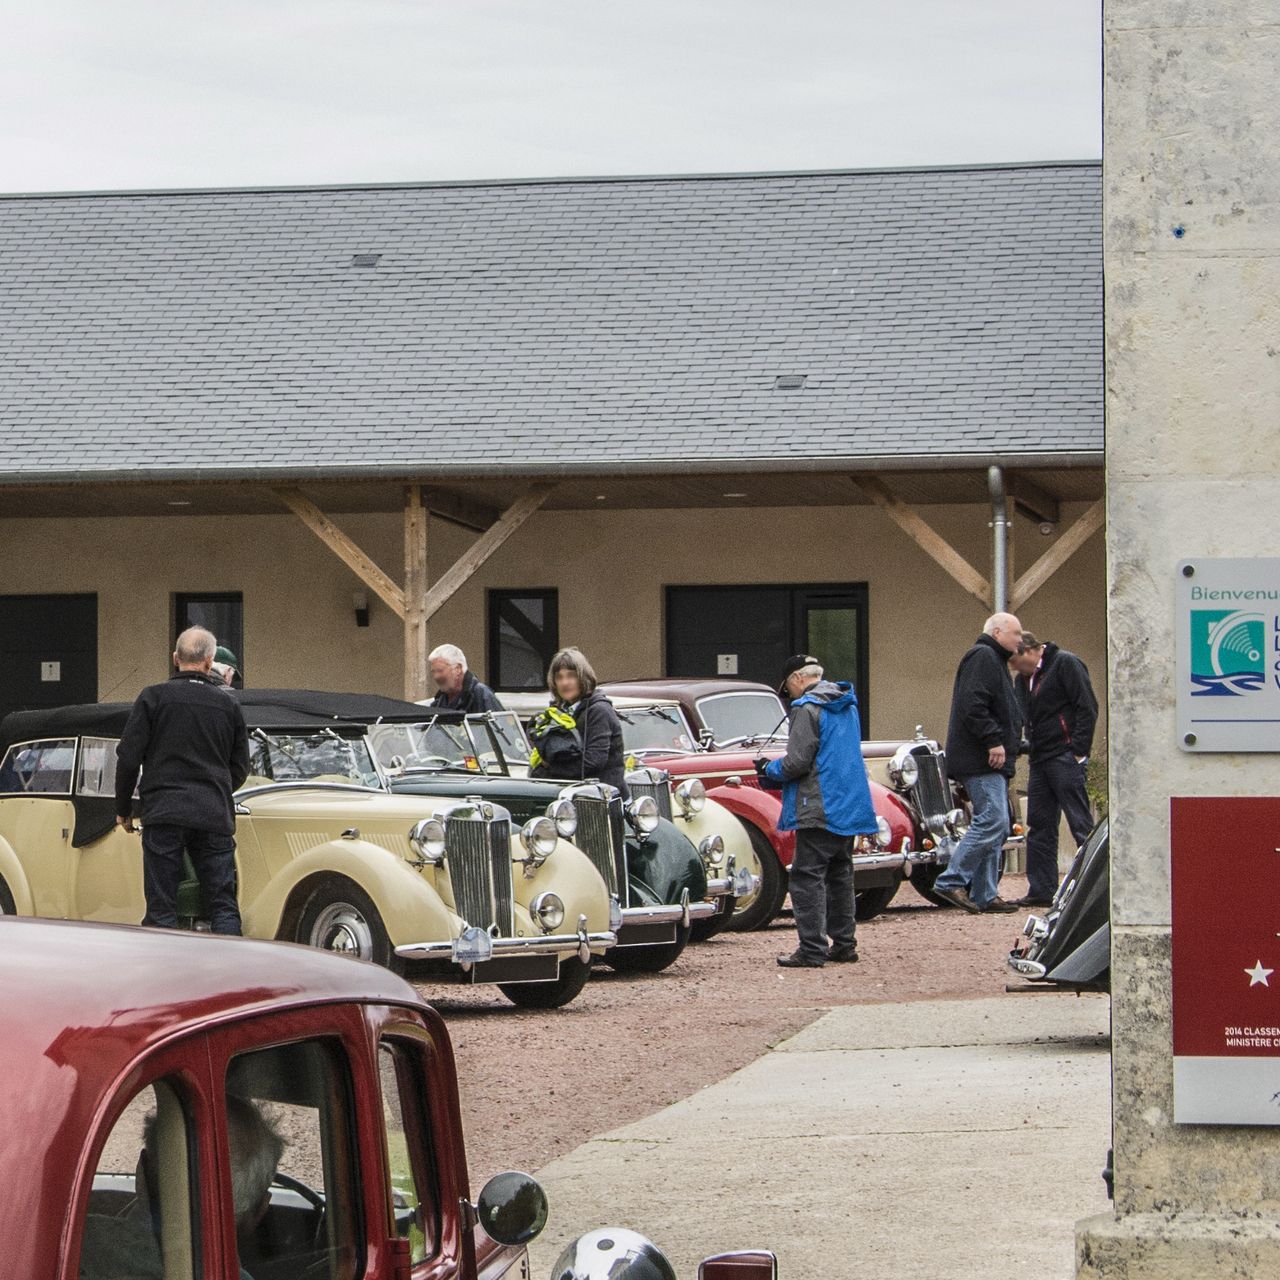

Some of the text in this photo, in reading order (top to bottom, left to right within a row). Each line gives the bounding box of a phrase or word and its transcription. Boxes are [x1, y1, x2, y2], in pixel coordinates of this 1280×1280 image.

[1190, 586, 1280, 601] Bienvenu
[1224, 1026, 1242, 1036] 2014
[1226, 1036, 1272, 1047] MINISTÈRE
